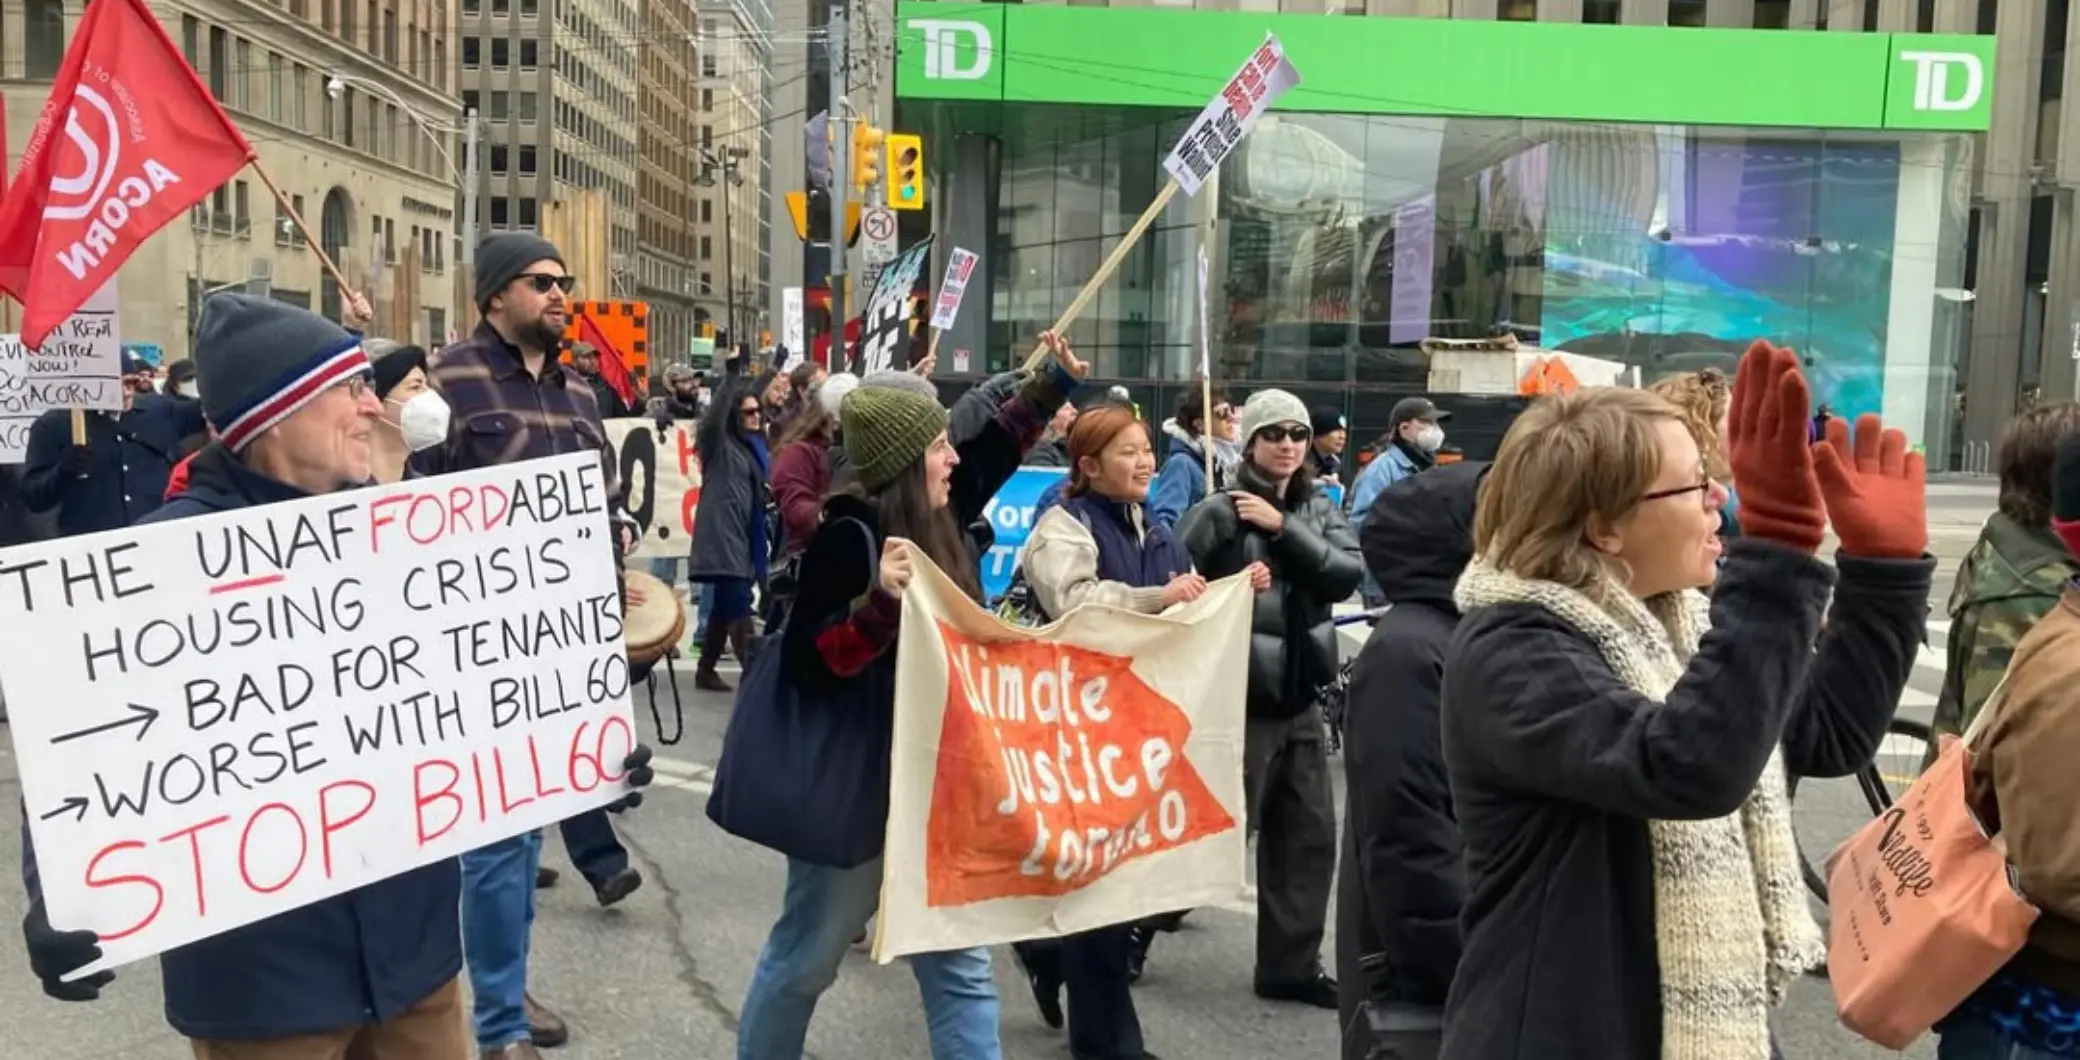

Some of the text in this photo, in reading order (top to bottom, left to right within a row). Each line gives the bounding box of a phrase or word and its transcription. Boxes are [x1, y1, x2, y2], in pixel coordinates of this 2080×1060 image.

[907, 19, 992, 79] TD
[1900, 51, 1984, 110] TD
[30, 381, 103, 405] ACORN
[83, 577, 364, 681] HOUSING
[185, 592, 623, 730] BAD FOR TENANTS
[94, 721, 327, 817] WORSE
[344, 690, 465, 754] WITH
[490, 669, 582, 729] BILL
[994, 728, 1172, 814] justice
[86, 780, 376, 941] STOP
[414, 734, 565, 846] BILL
[1019, 790, 1187, 881] torto
